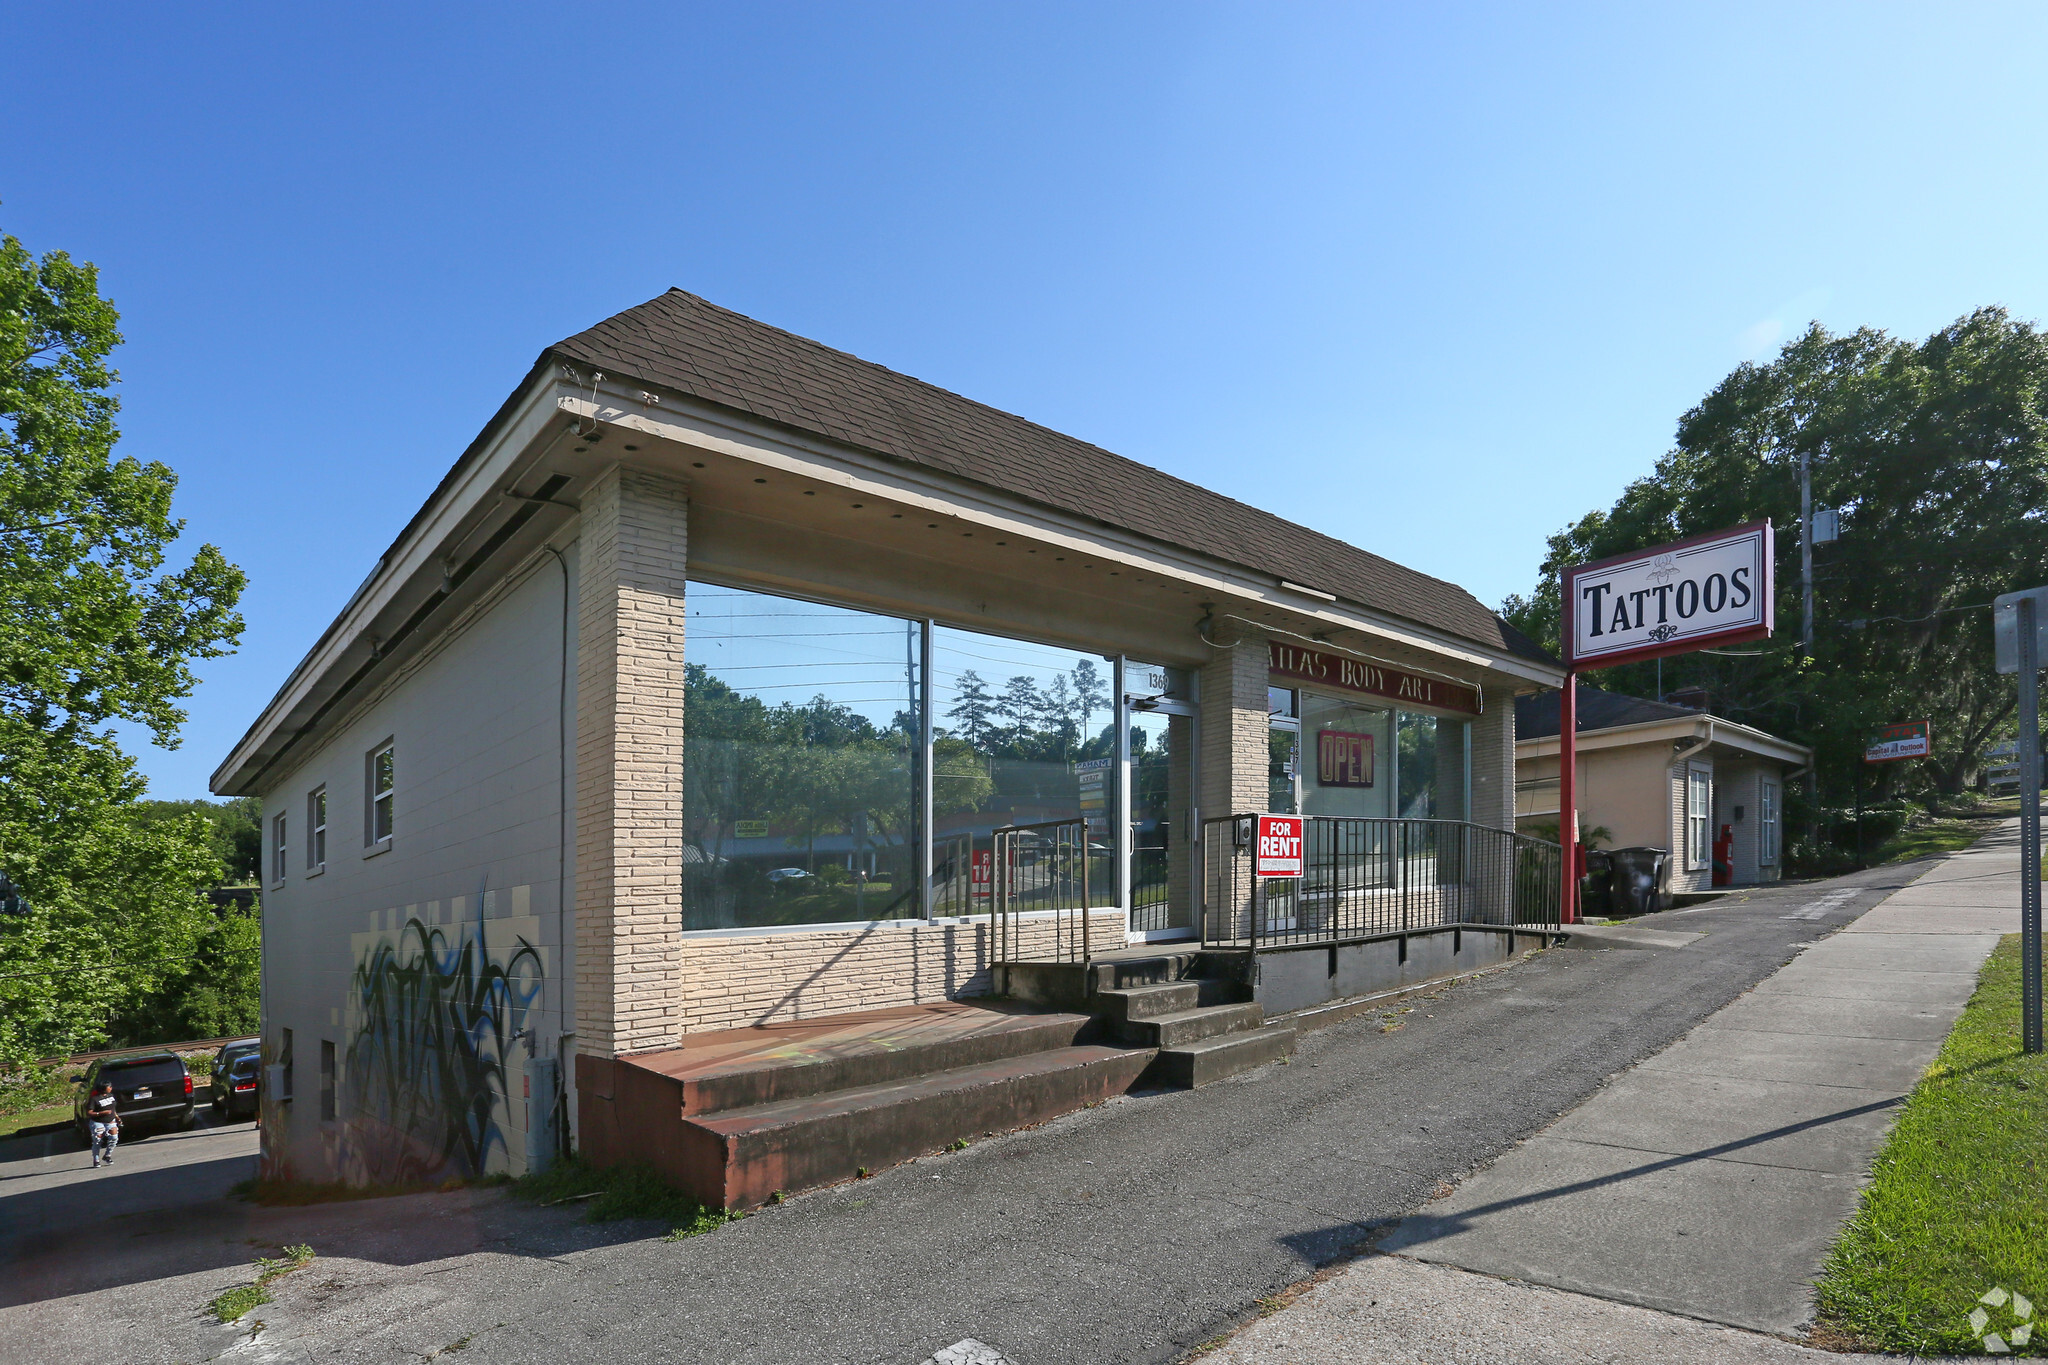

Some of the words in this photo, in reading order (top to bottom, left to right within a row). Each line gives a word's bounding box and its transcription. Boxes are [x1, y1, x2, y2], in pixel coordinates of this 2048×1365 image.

[1583, 567, 1751, 637] TATTOOS
[1148, 672, 1170, 690] 1369
[1341, 659, 1384, 691] BODY
[1900, 743, 1924, 752] Outlook
[1321, 735, 1373, 783] OPEN
[1269, 822, 1291, 836] FOR
[1260, 836, 1300, 857] RENT
